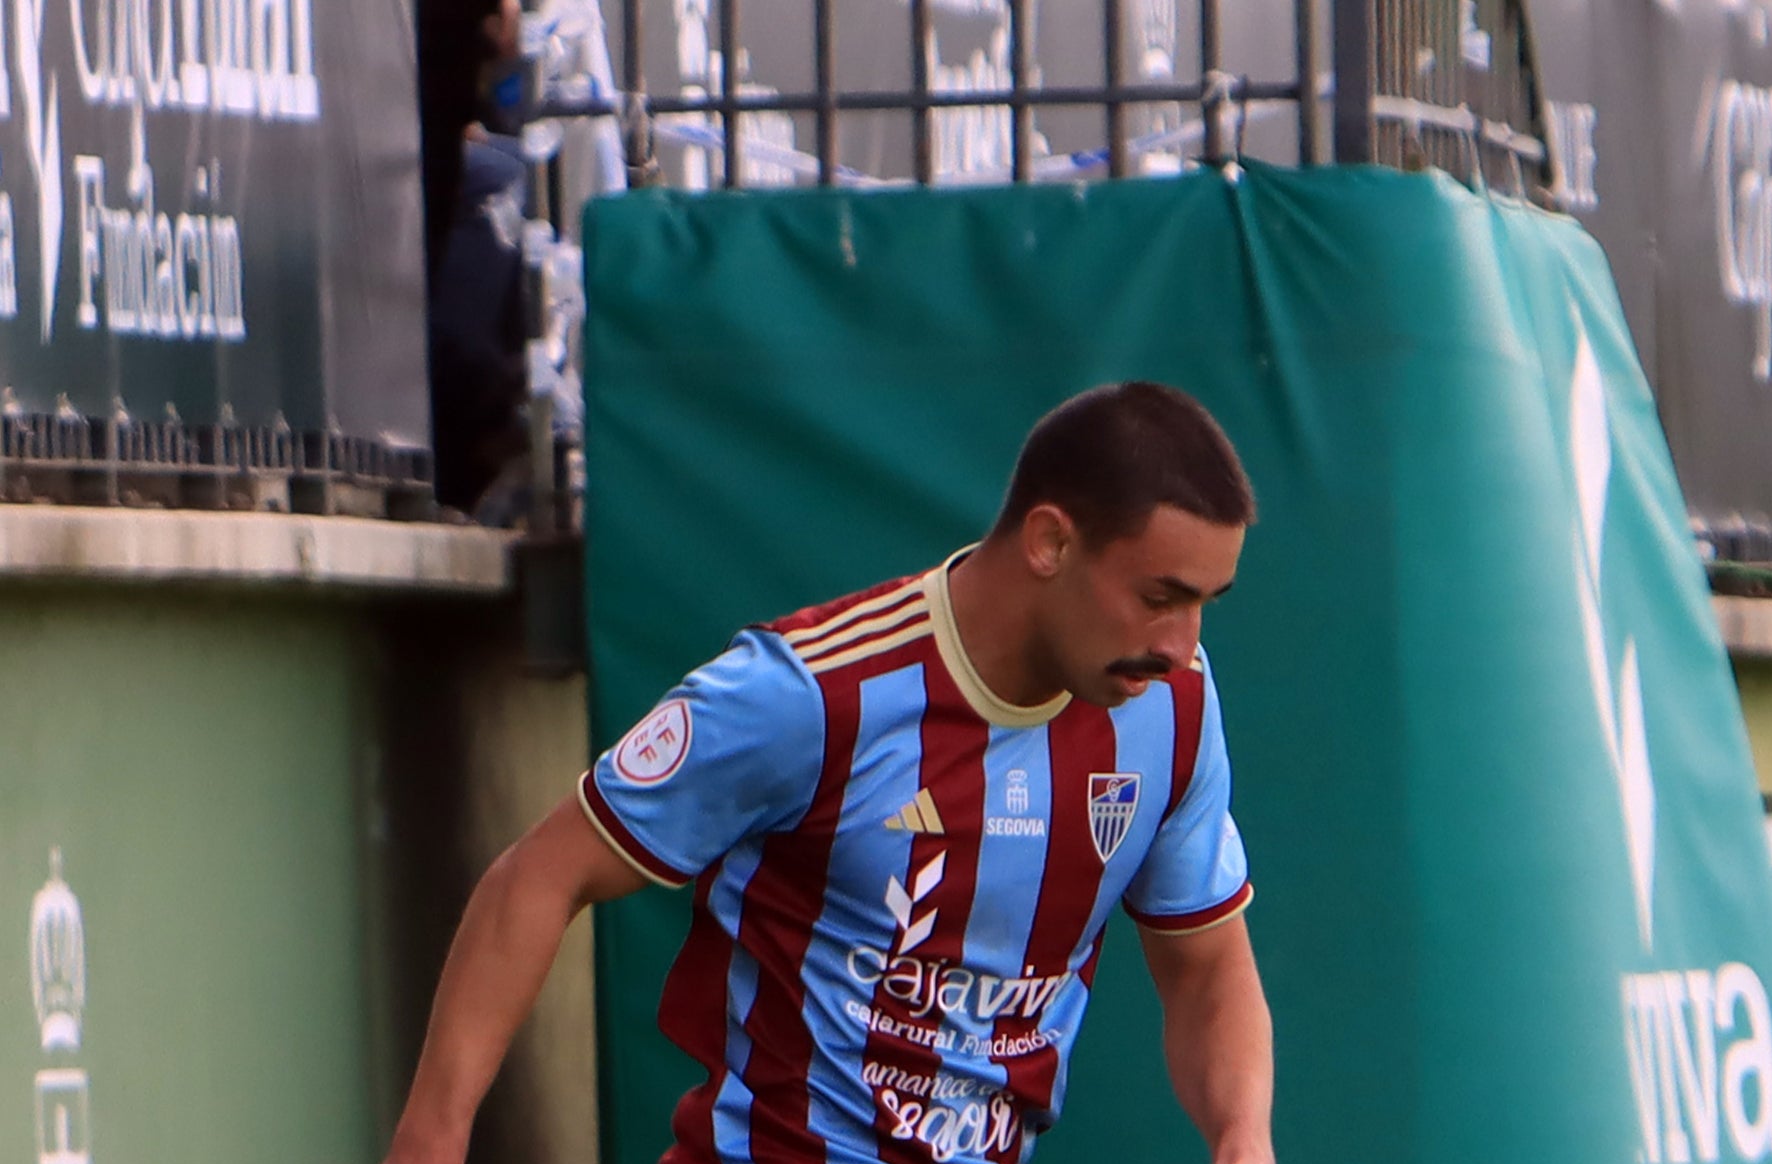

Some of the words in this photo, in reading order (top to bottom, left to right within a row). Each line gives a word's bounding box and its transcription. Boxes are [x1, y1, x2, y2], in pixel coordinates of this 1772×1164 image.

[986, 817, 1046, 838] SEGOVIA
[846, 946, 1074, 1019] cajaviv
[844, 998, 956, 1051] cajarural
